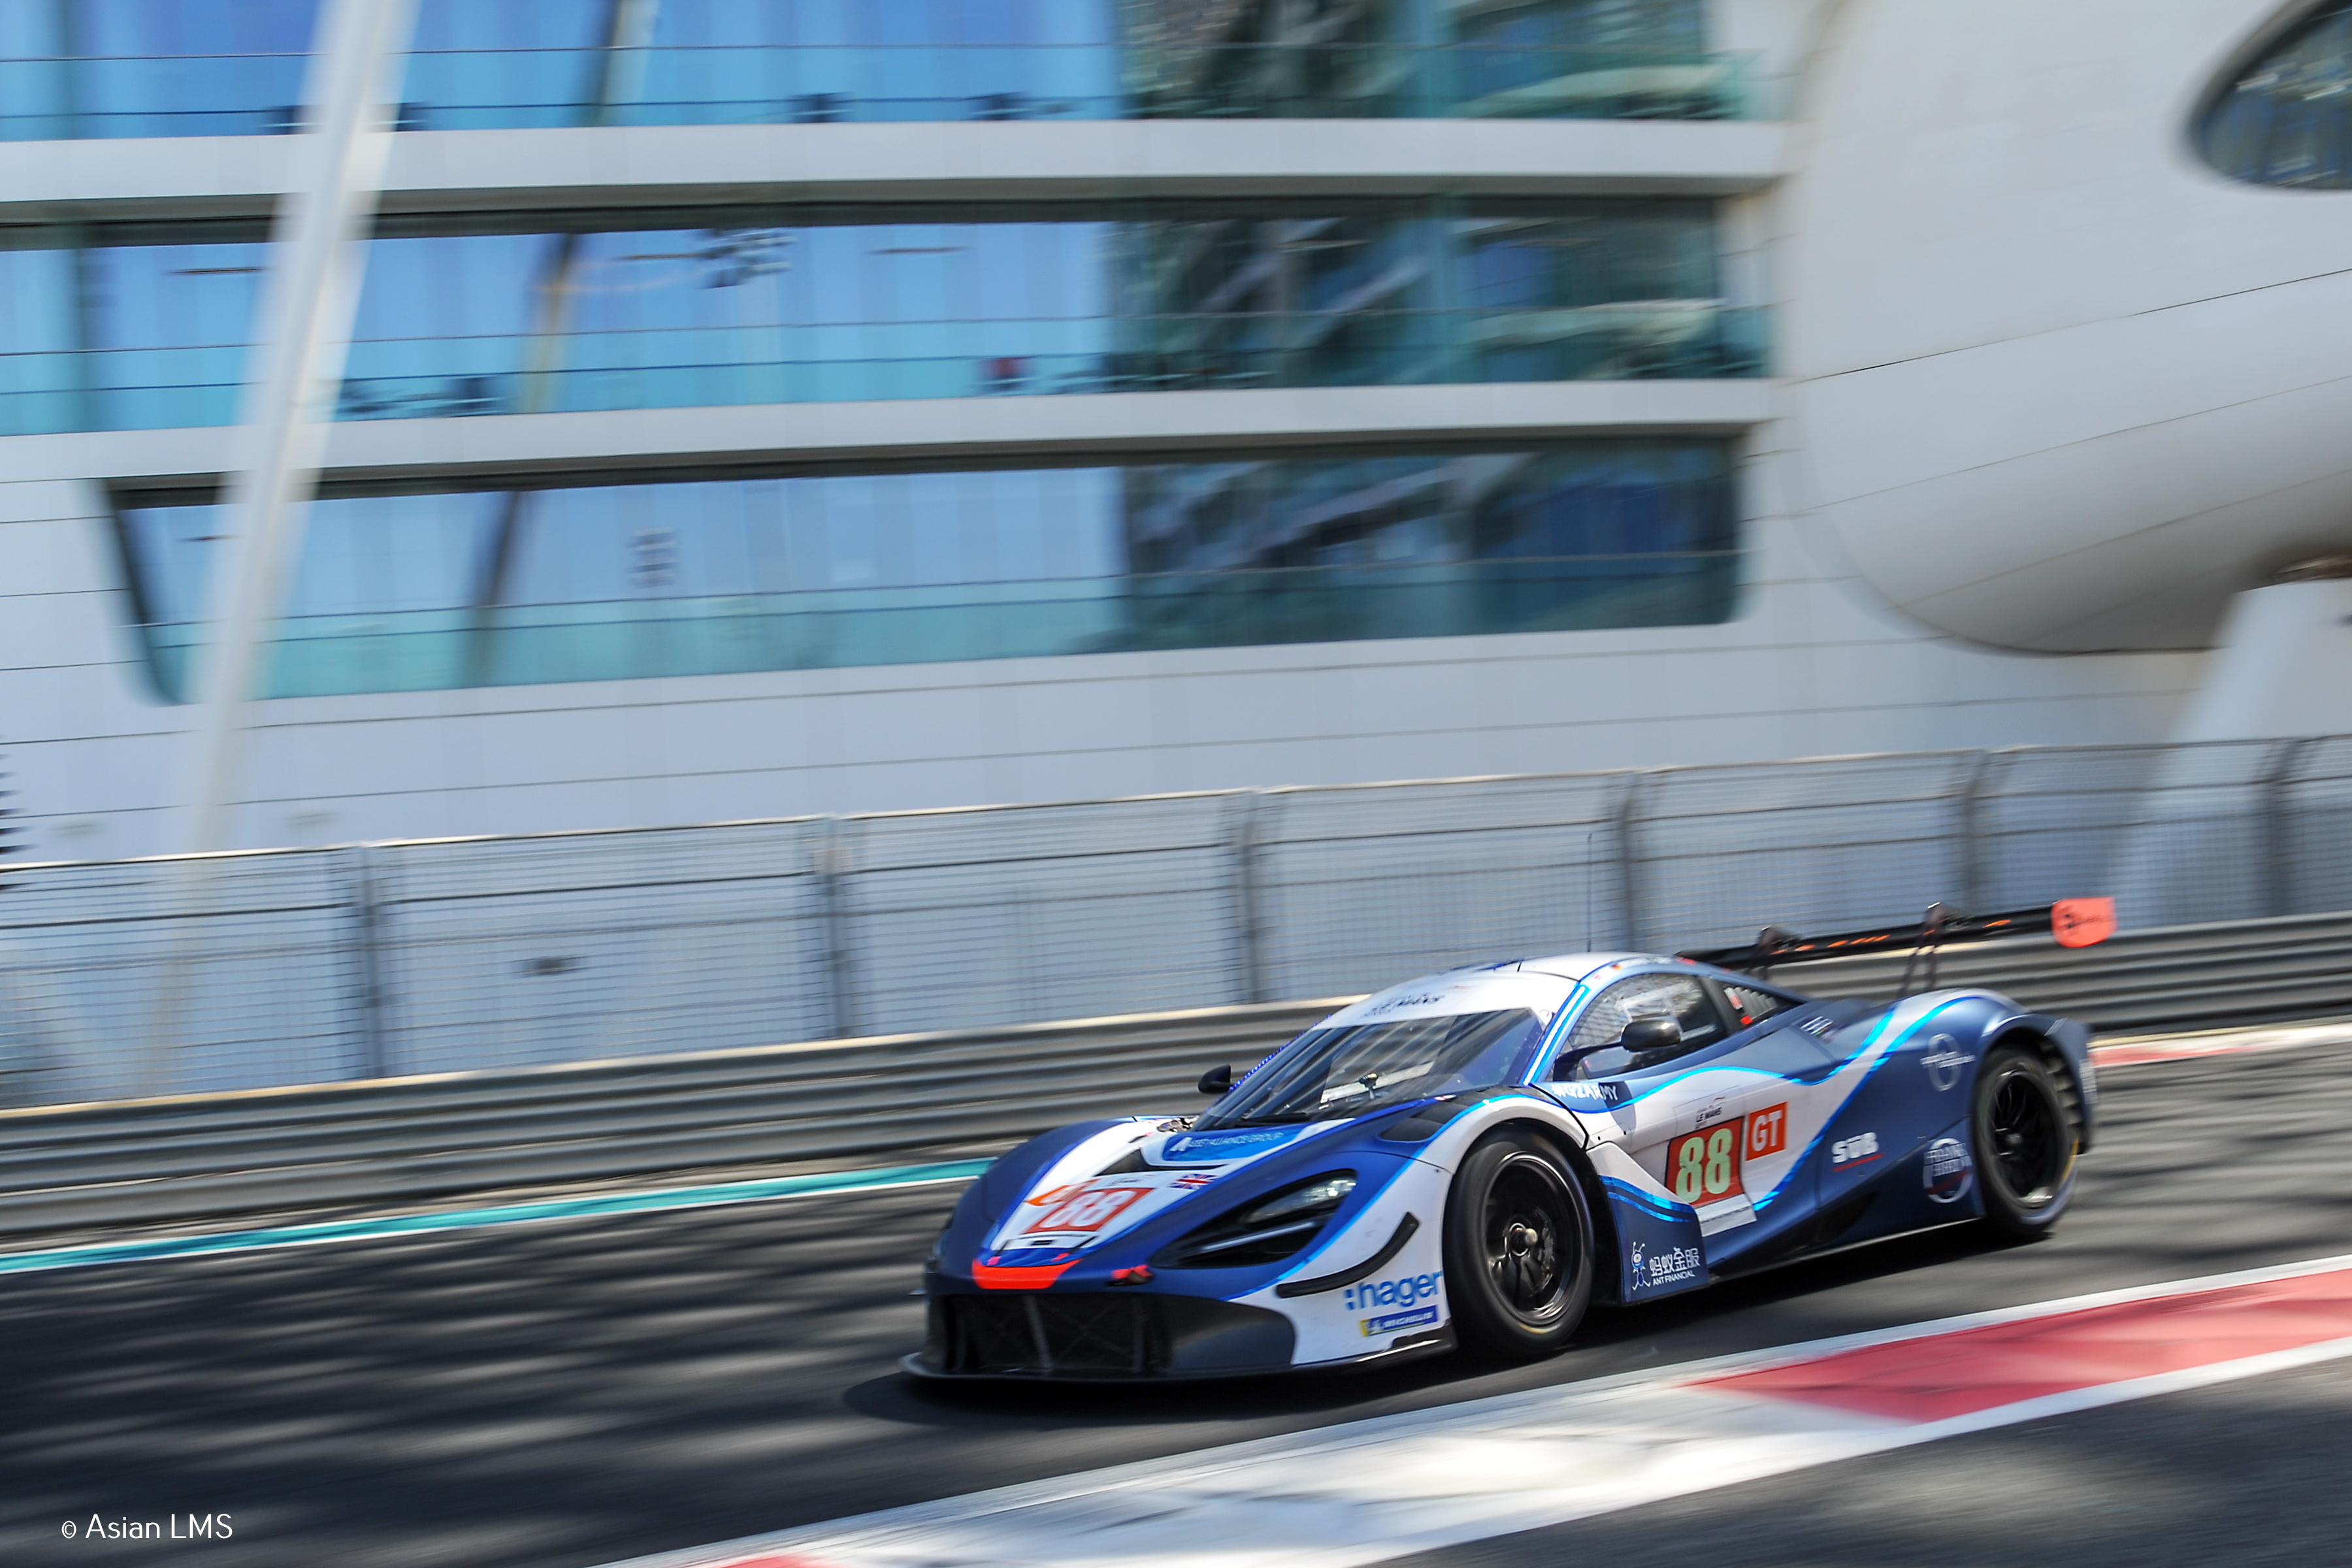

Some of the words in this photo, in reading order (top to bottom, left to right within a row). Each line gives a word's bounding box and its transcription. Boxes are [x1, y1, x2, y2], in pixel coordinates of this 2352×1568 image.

[1753, 1110, 1783, 1152] GT
[1676, 1128, 1733, 1203] 88
[1039, 1191, 1137, 1228] 88
[1649, 1247, 1701, 1277] 蚂蚁金服
[1653, 1277, 1664, 1286] ANT
[1665, 1270, 1695, 1283] FINANCIAL
